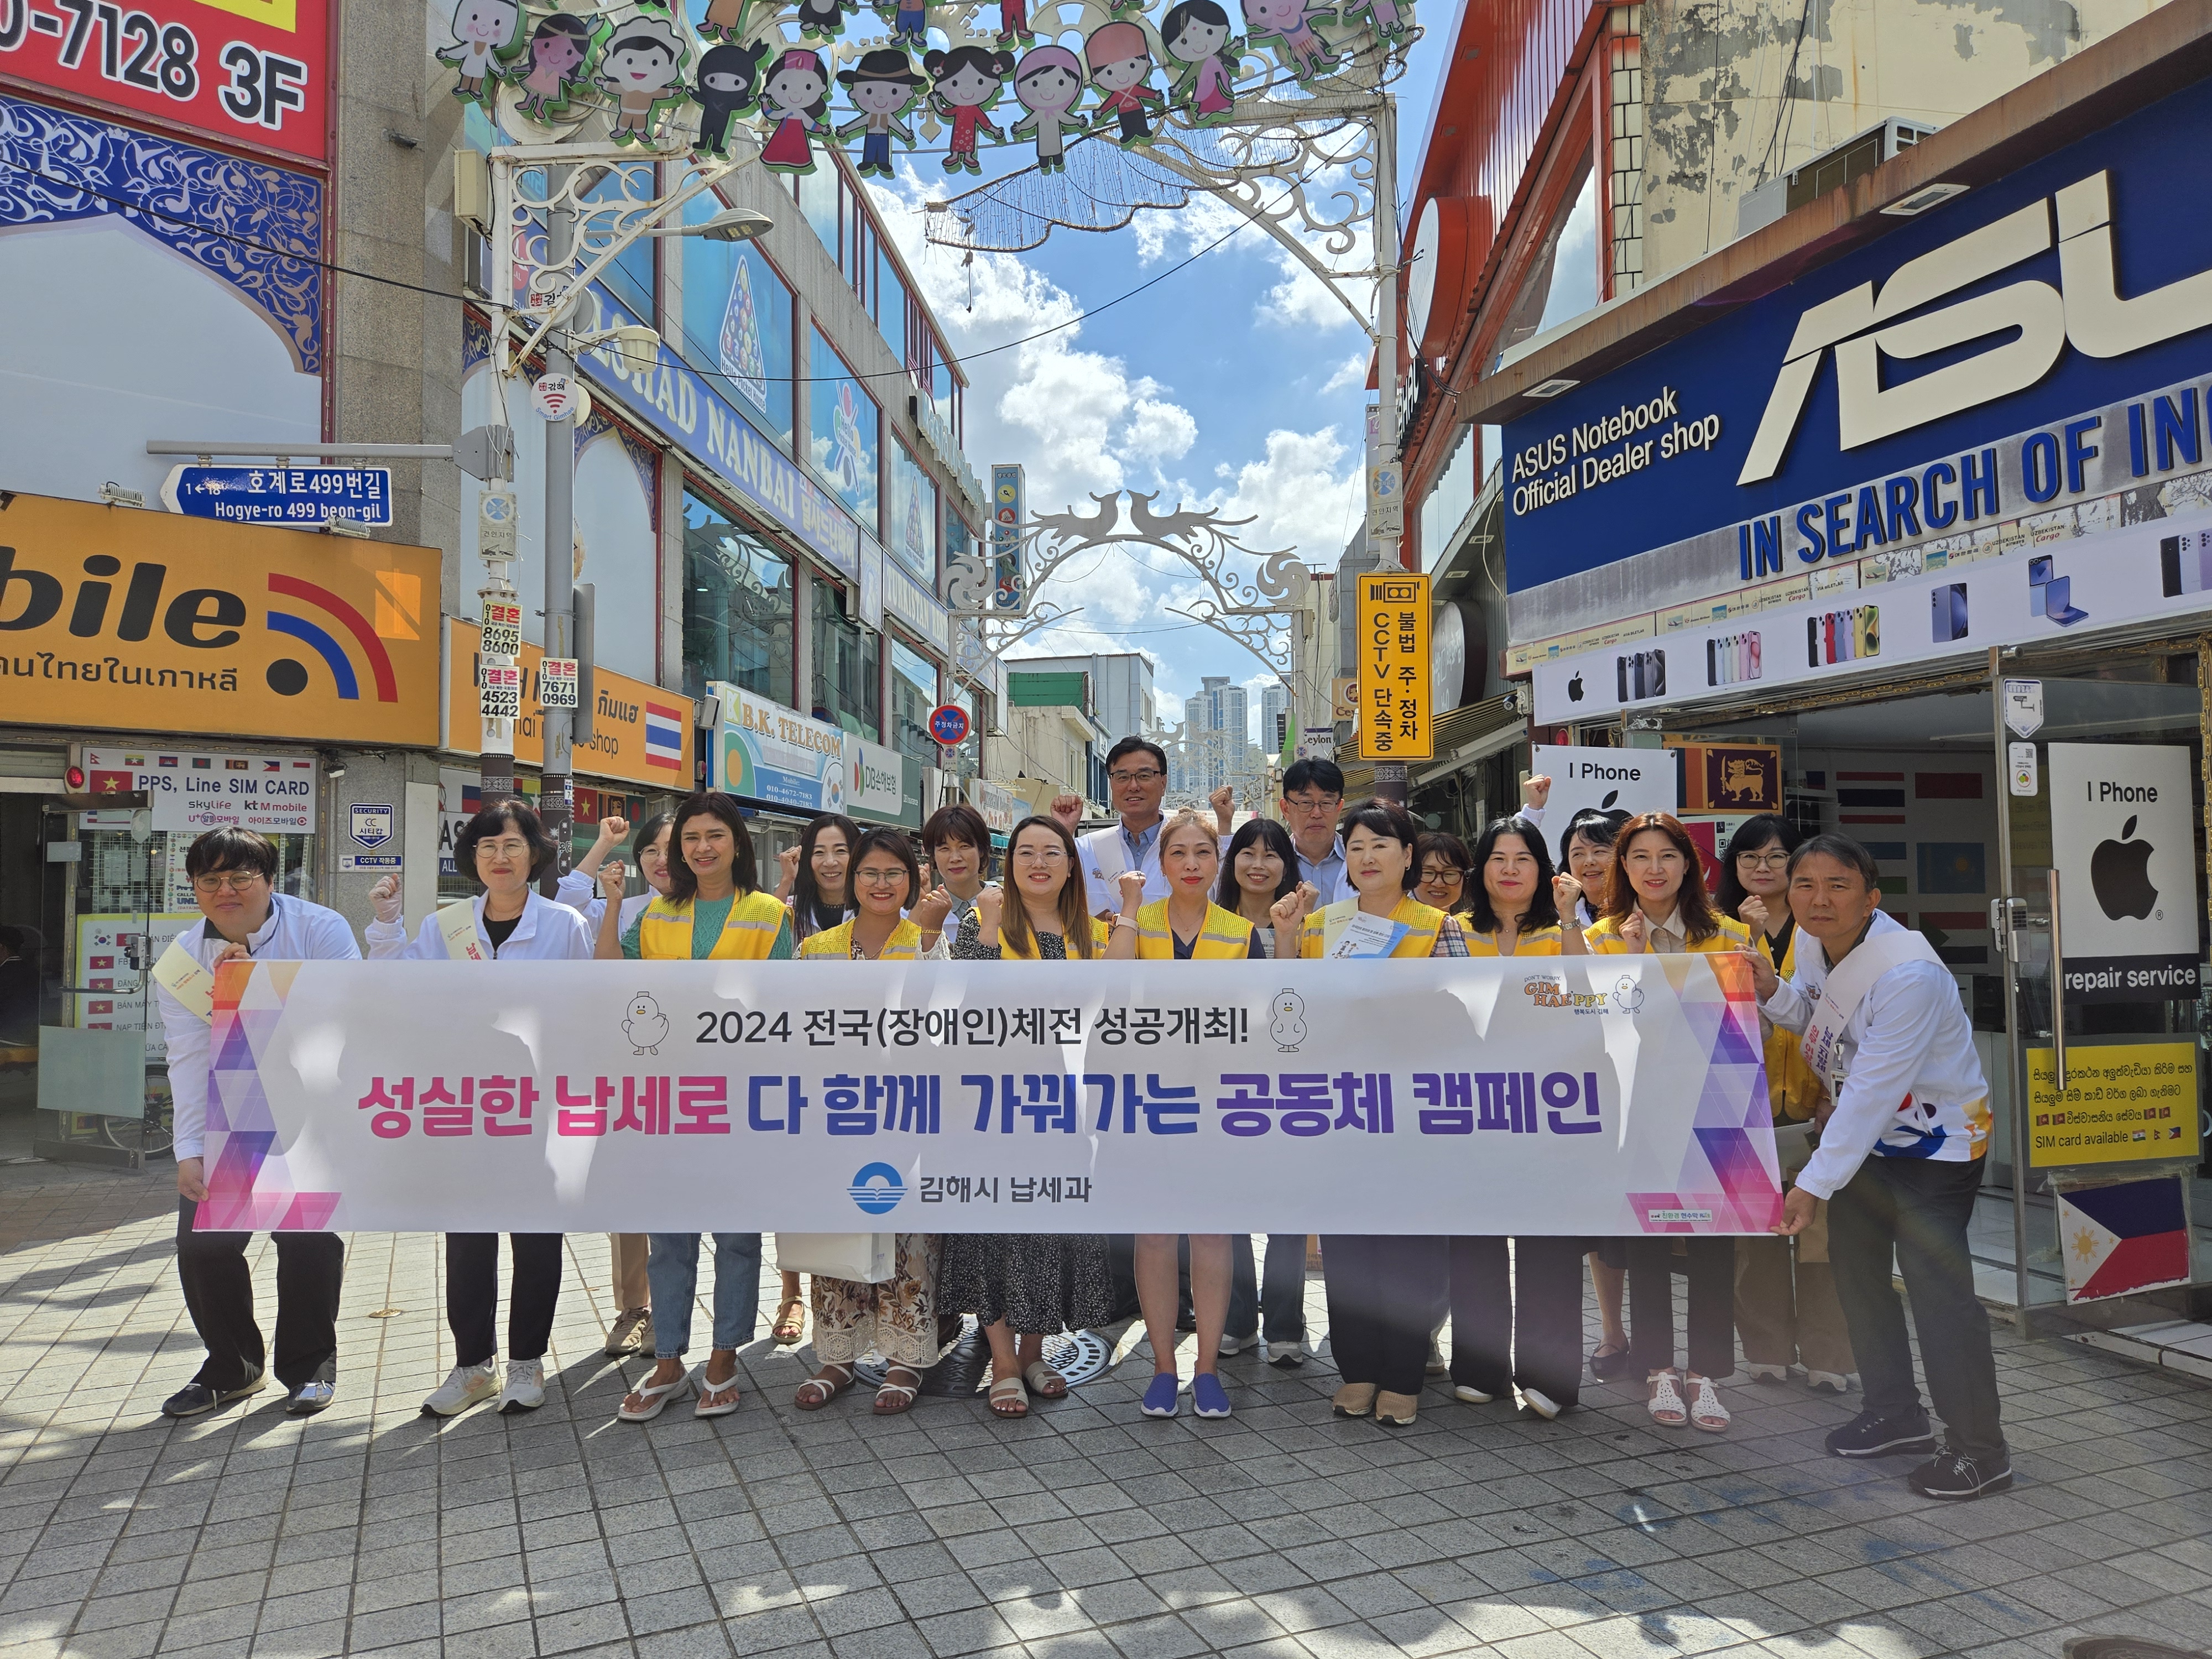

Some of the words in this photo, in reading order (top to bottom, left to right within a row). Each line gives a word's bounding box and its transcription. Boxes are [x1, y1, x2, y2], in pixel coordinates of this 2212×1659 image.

[218, 40, 307, 129] 3F
[548, 381, 565, 391] 김해
[535, 406, 552, 420] Smart
[554, 406, 575, 420] Gimhae
[1512, 434, 1567, 483] ASUS
[1572, 386, 1679, 457] Notebook
[706, 396, 795, 520] NANBAI
[1513, 473, 1576, 516] Official
[1584, 440, 1653, 489] Dealer
[1661, 414, 1719, 459] shop
[185, 483, 191, 494] 1
[1739, 515, 1782, 581] IN
[1797, 448, 2000, 564] SEARCH
[2022, 416, 2102, 503] OF
[2127, 383, 2212, 478] IN
[215, 502, 282, 520] Hogye-ro
[287, 503, 315, 518] 499
[321, 503, 381, 521] beon-gil
[1371, 505, 1399, 515] 견인지역
[2030, 524, 2064, 538] UZBEKISTAN
[2036, 531, 2060, 543] Cargo
[1992, 534, 2025, 546] UZBEKISTAN
[886, 563, 929, 632] TURKISTAN
[1759, 594, 1782, 603] UZBEKISTAN
[1785, 587, 1809, 597] UZBEKISTAN
[1788, 593, 1806, 602] Cargo
[492, 604, 520, 624] 결혼
[483, 627, 519, 643] 8695
[1398, 612, 1416, 653] 불법
[482, 640, 519, 655] 8600
[1374, 612, 1390, 679] CCTV
[548, 661, 576, 676] 결혼
[488, 669, 518, 685] 결혼
[542, 681, 575, 693] 7671
[482, 691, 518, 703] 4523
[542, 693, 576, 706] 0969
[482, 704, 518, 717] 4442
[935, 721, 964, 729] 주정차금지
[1374, 688, 1393, 752] 단속중
[742, 703, 775, 739] B.K.
[779, 716, 842, 760] TELECOM
[865, 765, 896, 795] DB손해보험
[1582, 763, 1641, 781] Phone
[138, 775, 177, 793] PPS,
[186, 777, 221, 792] Line
[229, 779, 258, 794] SIM
[265, 780, 310, 795] CARD
[782, 776, 800, 786] Mobile:
[766, 784, 812, 800] 010-4672-7183
[2101, 782, 2158, 804] Phone
[188, 800, 232, 810] skylife
[244, 800, 259, 811] kt
[273, 802, 307, 812] mobile
[766, 794, 813, 808] 010-4040-7183
[248, 816, 297, 825] 아이즈모바일
[442, 859, 458, 872] ALL
[1524, 974, 1540, 983] DON'T
[2064, 966, 2122, 992] repair
[2127, 963, 2197, 988] service
[1524, 981, 1560, 995] GIM
[696, 1010, 792, 1045] 2024
[802, 1006, 1083, 1047] 전국(장애인)체전
[1094, 1006, 1249, 1046] 성공개최!
[2033, 1068, 2055, 1084] සියලු
[2178, 1064, 2193, 1074] සහ
[2034, 1091, 2063, 1107] සියලුම
[2130, 1086, 2148, 1102] ලබා
[357, 1074, 540, 1139] 성실한
[555, 1075, 731, 1136] 납세로
[748, 1075, 808, 1135] 다
[823, 1073, 941, 1136] 함께
[1217, 1072, 1394, 1137] 공동체
[1412, 1072, 1603, 1135] 캠페인
[2036, 1135, 2056, 1149] SIM
[2058, 1133, 2081, 1147] card
[2084, 1130, 2128, 1145] available
[920, 1175, 1000, 1203] 김해시
[1010, 1175, 1093, 1204] 납세과
